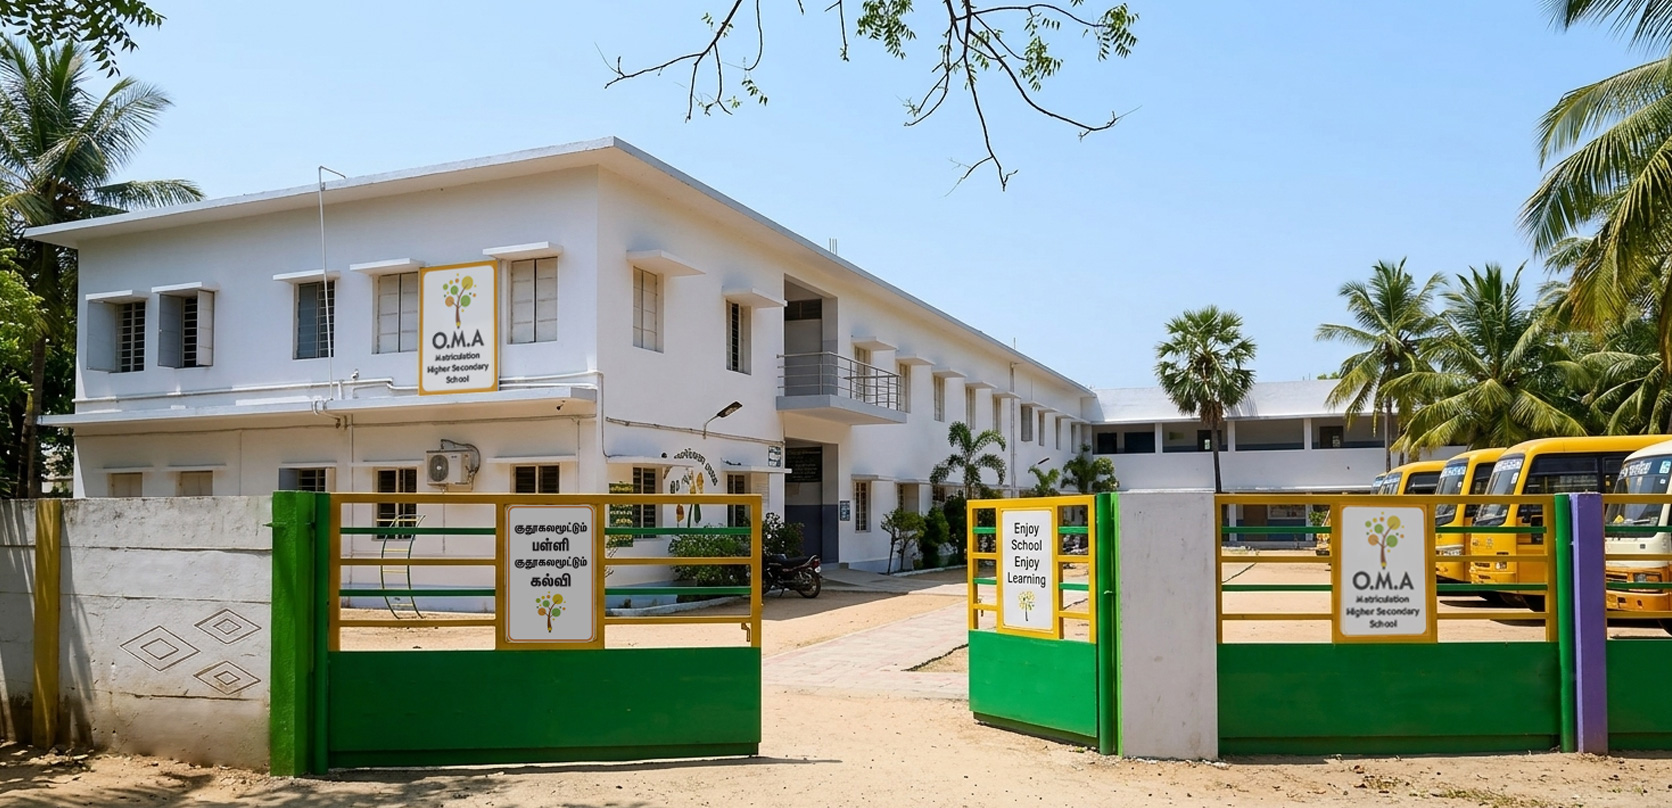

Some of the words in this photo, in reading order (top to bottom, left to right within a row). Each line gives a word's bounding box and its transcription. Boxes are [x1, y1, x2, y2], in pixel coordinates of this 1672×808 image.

[432, 329, 484, 350] O.M.A
[435, 352, 480, 361] Matriculation
[427, 365, 450, 375] Higher
[451, 363, 489, 373] Secondary
[446, 375, 469, 384] School
[514, 522, 588, 535] குதூகலமூட்டும்
[1014, 522, 1040, 537] Enjoy
[532, 537, 570, 552] பள்ளி
[1011, 539, 1042, 551] School
[514, 556, 588, 569] குதூகலமூட்டும்
[1014, 556, 1040, 571] Enjoy
[530, 573, 571, 587] கல்வி
[1007, 572, 1046, 588] Learning
[1352, 571, 1414, 590] O.M.A
[1355, 595, 1410, 603] Matriculation
[1346, 607, 1375, 618] Higher
[1376, 607, 1420, 617] Secondary
[1369, 619, 1397, 628] School
